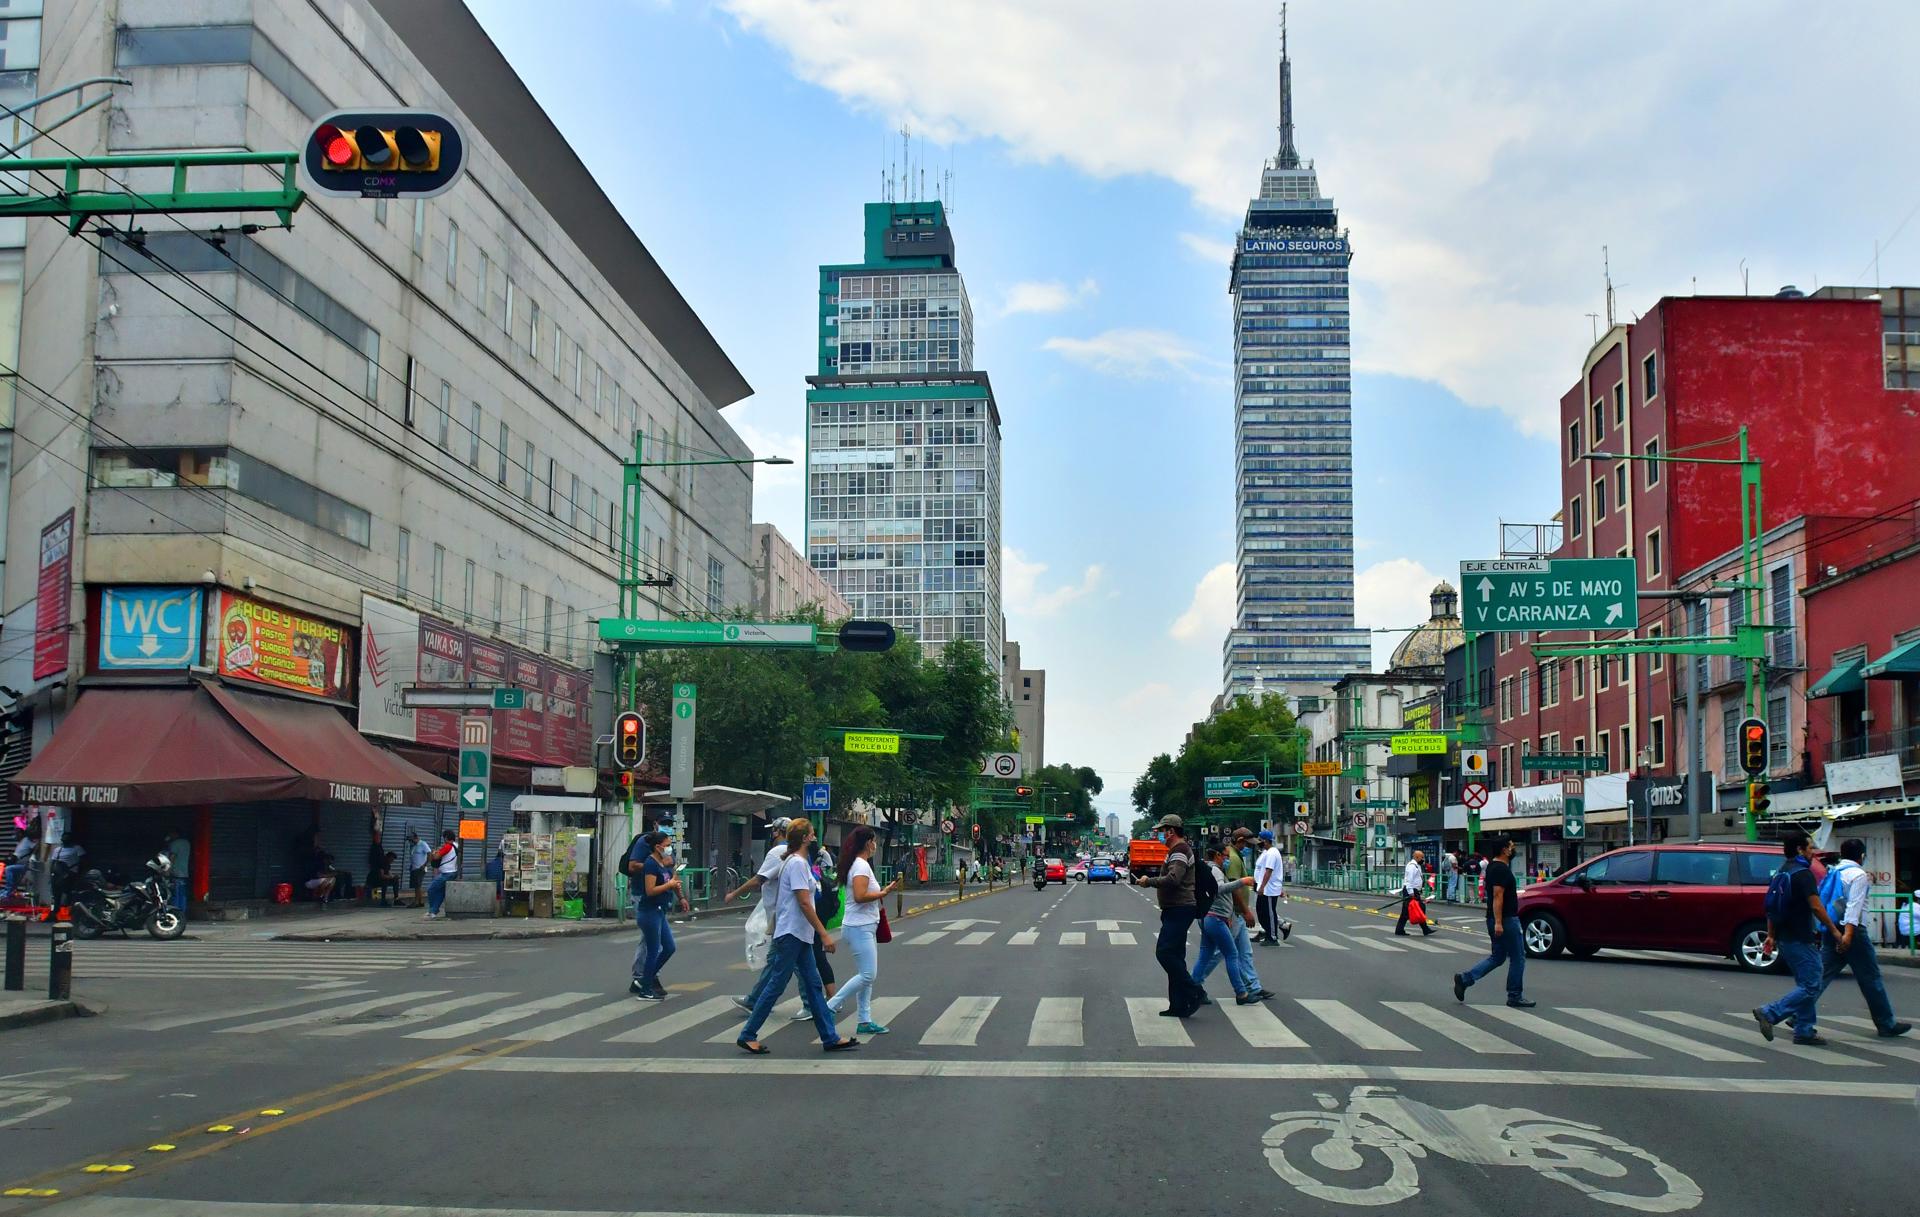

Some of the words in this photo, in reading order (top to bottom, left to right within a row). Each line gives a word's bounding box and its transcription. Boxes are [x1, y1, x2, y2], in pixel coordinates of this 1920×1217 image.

[364, 176, 396, 186] CDMX
[1245, 241, 1286, 251] LATINO
[1287, 240, 1343, 251] SEGUROS
[1466, 562, 1487, 571] EJE
[1492, 562, 1542, 571] CENTRAL
[1508, 581, 1528, 598] AV
[1535, 581, 1545, 598] 5
[1552, 580, 1573, 597] DE
[1581, 579, 1622, 597] MAYO
[120, 599, 182, 634] WC
[233, 598, 280, 625] TACOS
[282, 613, 291, 629] Y
[294, 617, 339, 643] TORTAS
[1476, 606, 1488, 623] V
[1496, 604, 1591, 623] CARRANZA
[260, 627, 287, 642] PASTOR
[260, 641, 291, 657] SUADERO
[424, 630, 448, 654] YAIKA
[449, 638, 463, 659] SPA
[260, 654, 296, 670] LONGANIZA
[503, 693, 514, 704] 8
[850, 743, 893, 751] TROLEBUS
[863, 736, 896, 744] PREFERENTE
[20, 785, 76, 803] TAQUERIA
[82, 786, 118, 803] POCHO
[328, 782, 370, 803] TAQUERIA
